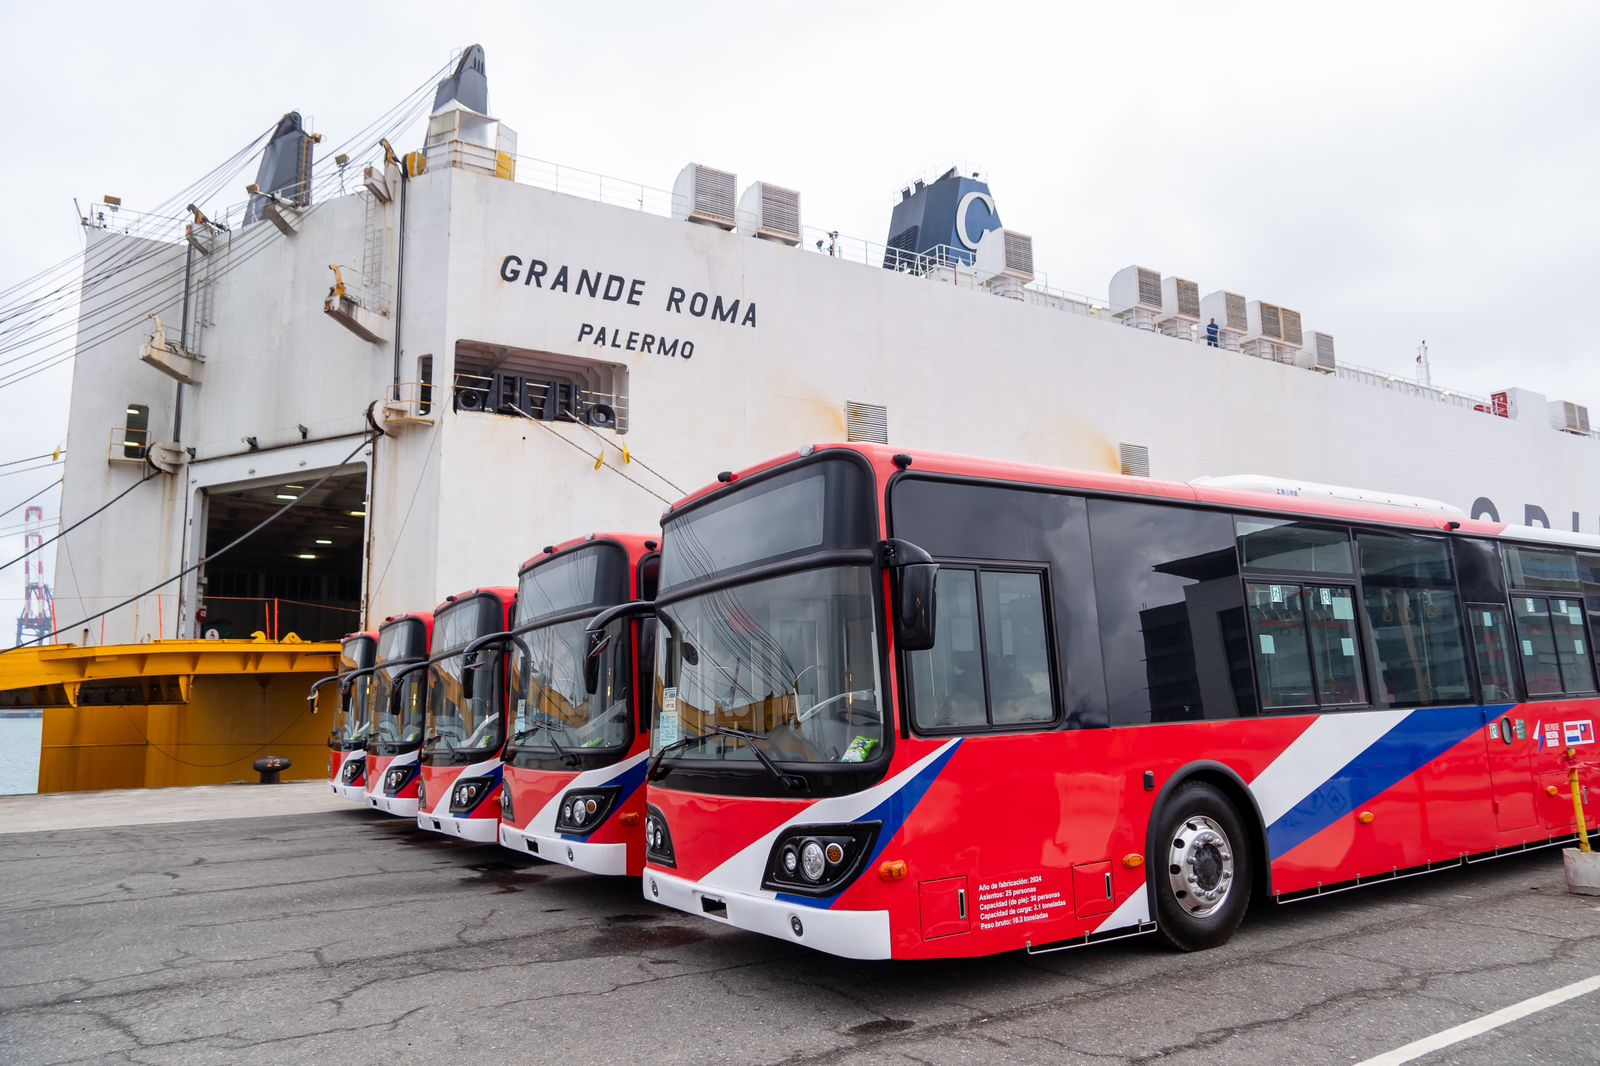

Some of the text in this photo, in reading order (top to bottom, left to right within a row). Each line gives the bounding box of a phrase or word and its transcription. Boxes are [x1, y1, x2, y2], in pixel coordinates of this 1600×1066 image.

[500, 255, 757, 328] GRANDE ROMA
[577, 323, 695, 360] PALERMO
[998, 878, 1029, 888] fabricación:
[979, 892, 1004, 901] Asientos:
[1013, 887, 1036, 896] personas
[980, 900, 1008, 910] Capacidad
[1008, 899, 1017, 907] (de
[1037, 892, 1060, 902] personas
[980, 910, 1008, 920] Capacidad
[1017, 906, 1033, 914] carga:
[1042, 900, 1066, 909] toneladas
[995, 920, 1012, 928] bruto:
[1024, 913, 1049, 921] toneladas
